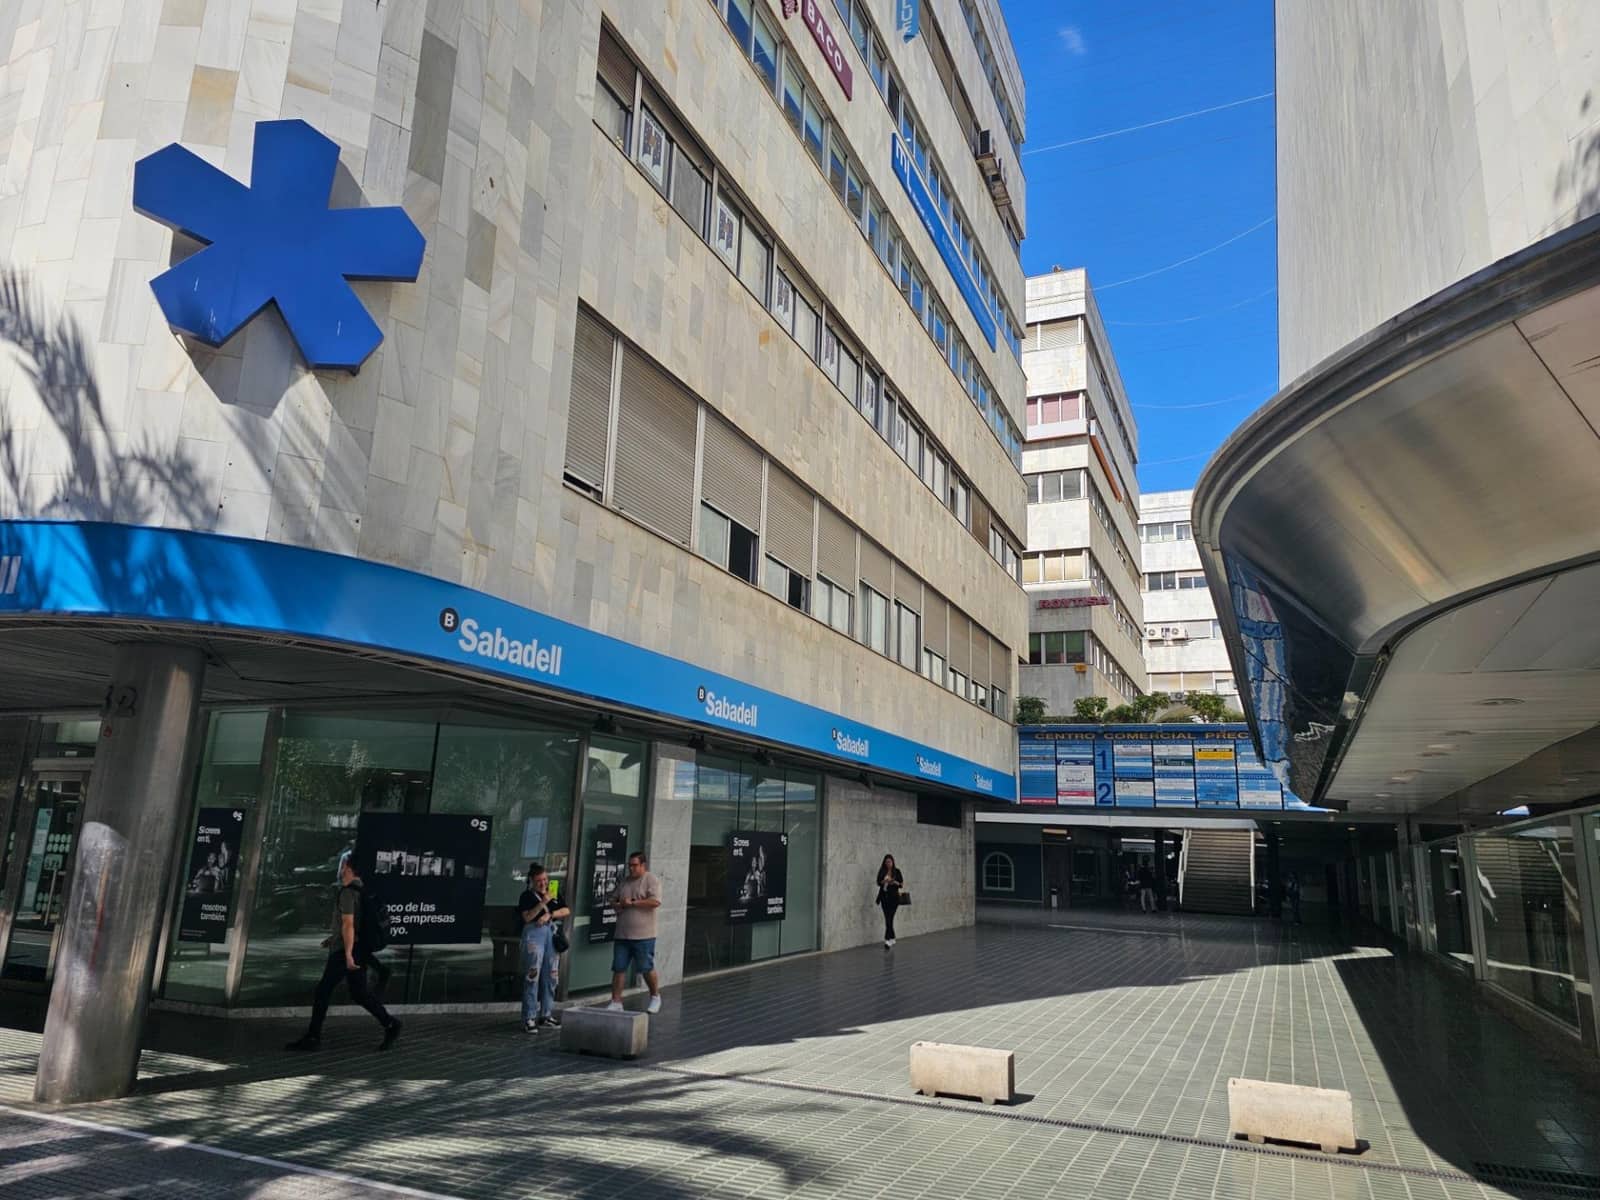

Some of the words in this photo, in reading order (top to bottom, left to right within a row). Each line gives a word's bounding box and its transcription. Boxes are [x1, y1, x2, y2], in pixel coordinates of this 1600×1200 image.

[458, 618, 562, 676] Sabadell
[705, 691, 757, 728] Sabadell
[836, 731, 869, 758] Sabadell
[1034, 732, 1096, 741] CENTRO
[1104, 732, 1196, 741] COMERCIAL
[919, 756, 942, 777] Sabadell
[1097, 750, 1107, 770] 1
[1098, 783, 1112, 804] 2
[405, 901, 418, 912] de
[419, 902, 436, 912] las
[402, 915, 456, 926] empresas
